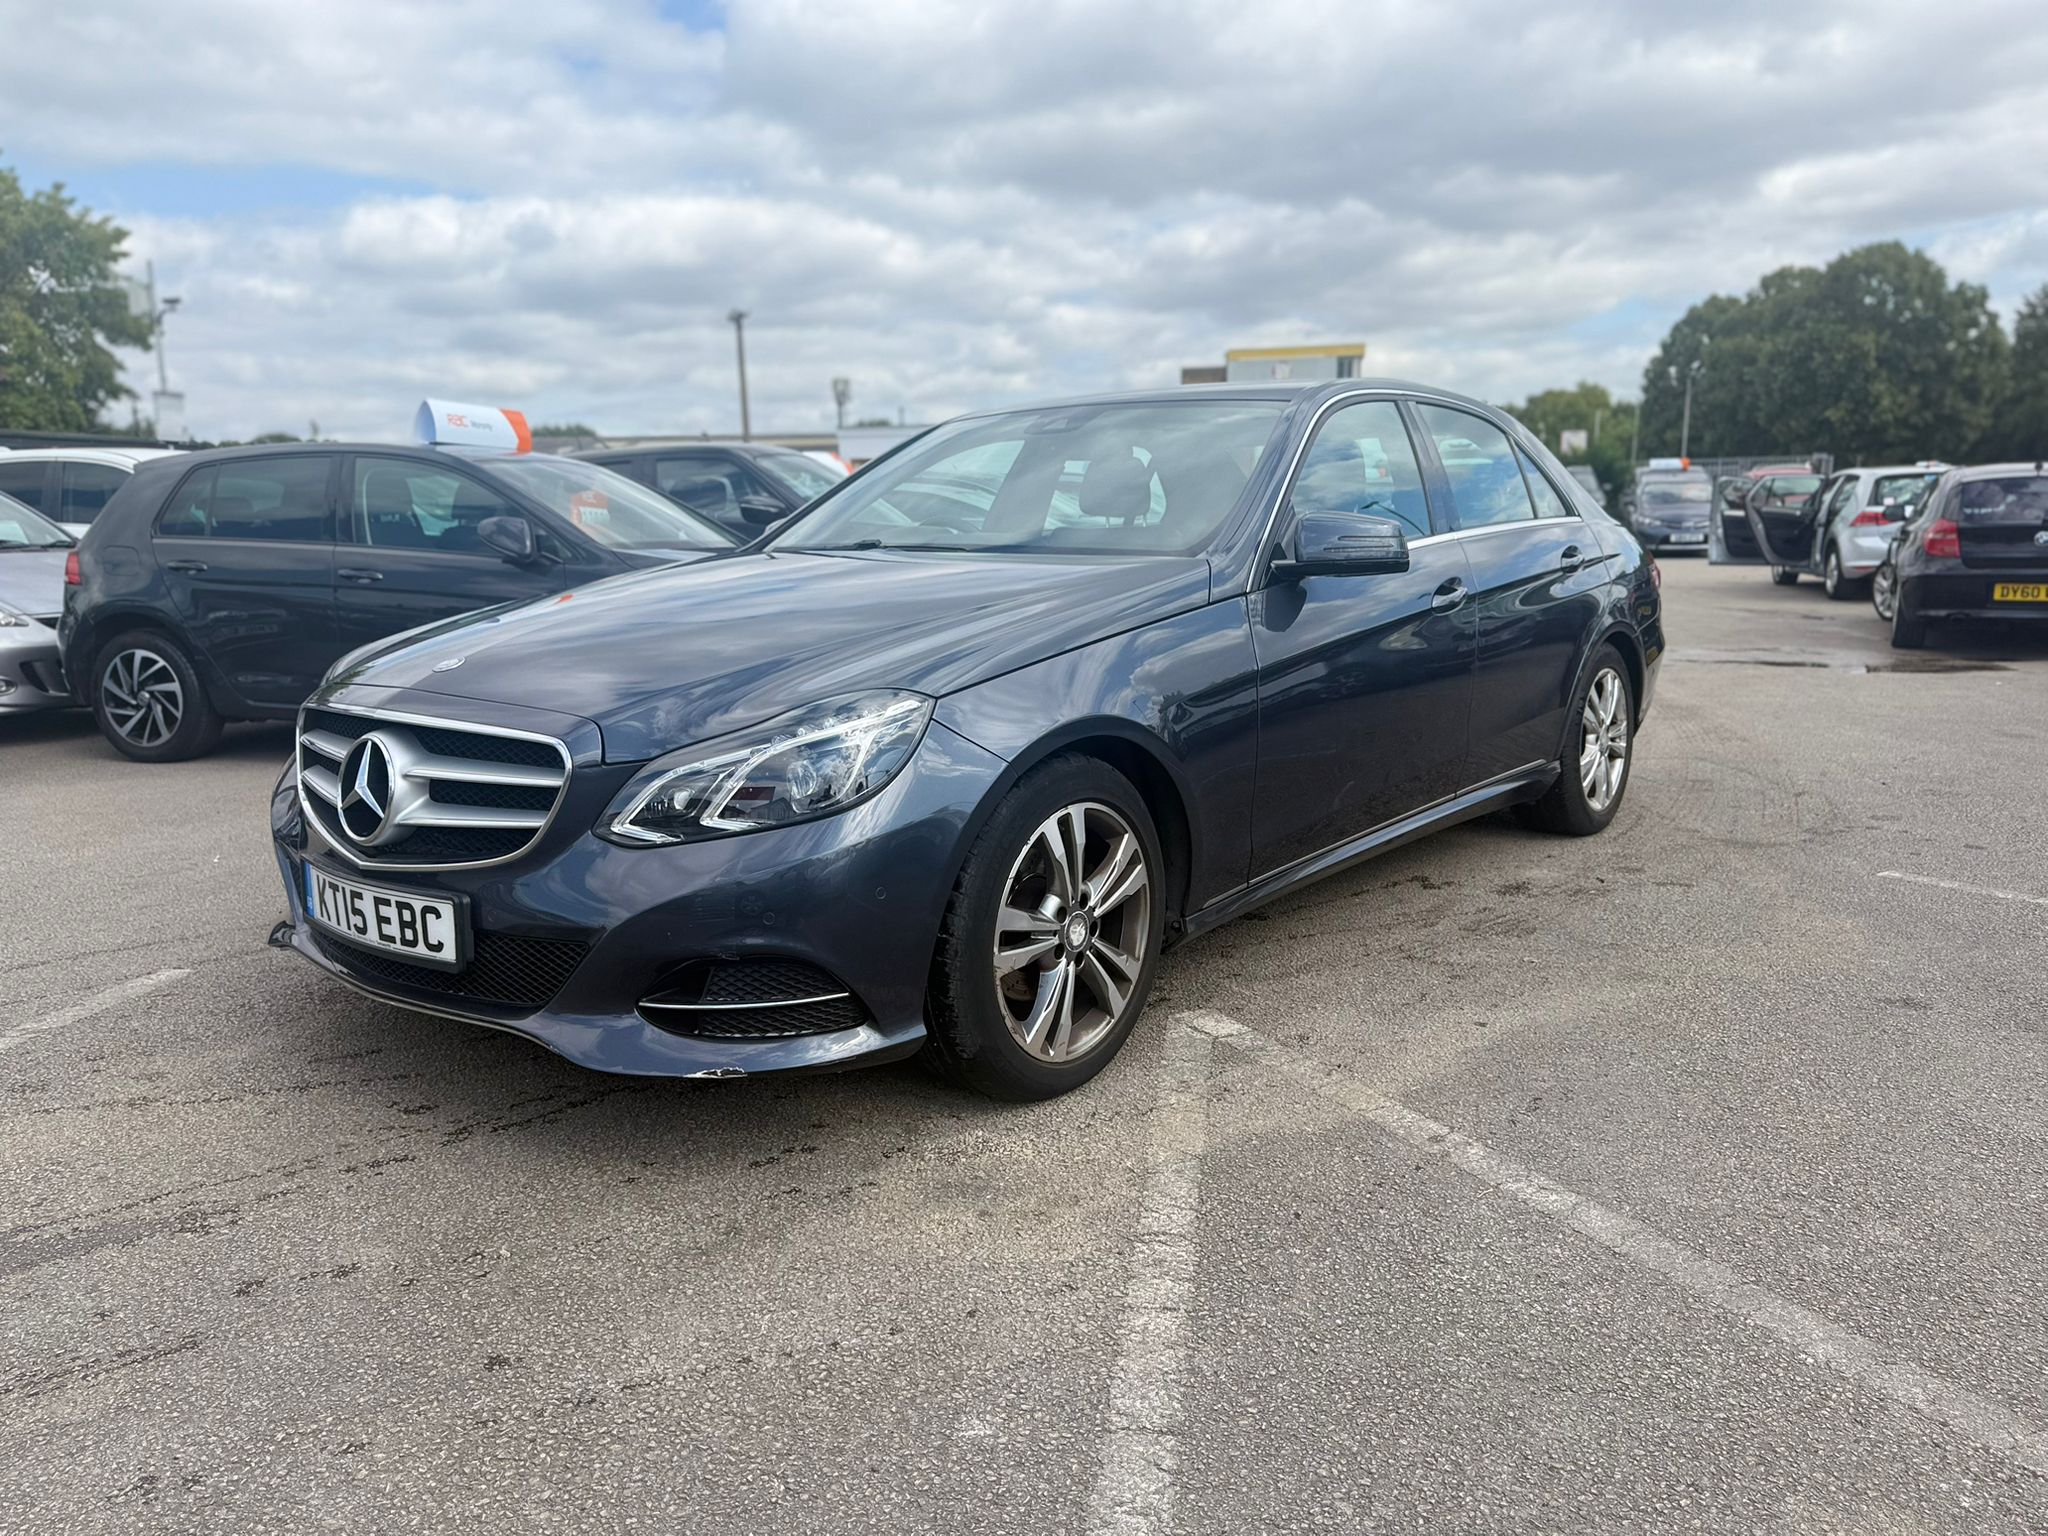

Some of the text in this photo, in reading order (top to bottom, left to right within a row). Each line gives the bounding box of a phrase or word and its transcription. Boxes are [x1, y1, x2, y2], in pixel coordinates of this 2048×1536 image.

[2000, 585, 2041, 599] DY60
[316, 873, 445, 953] KT15 EBC
